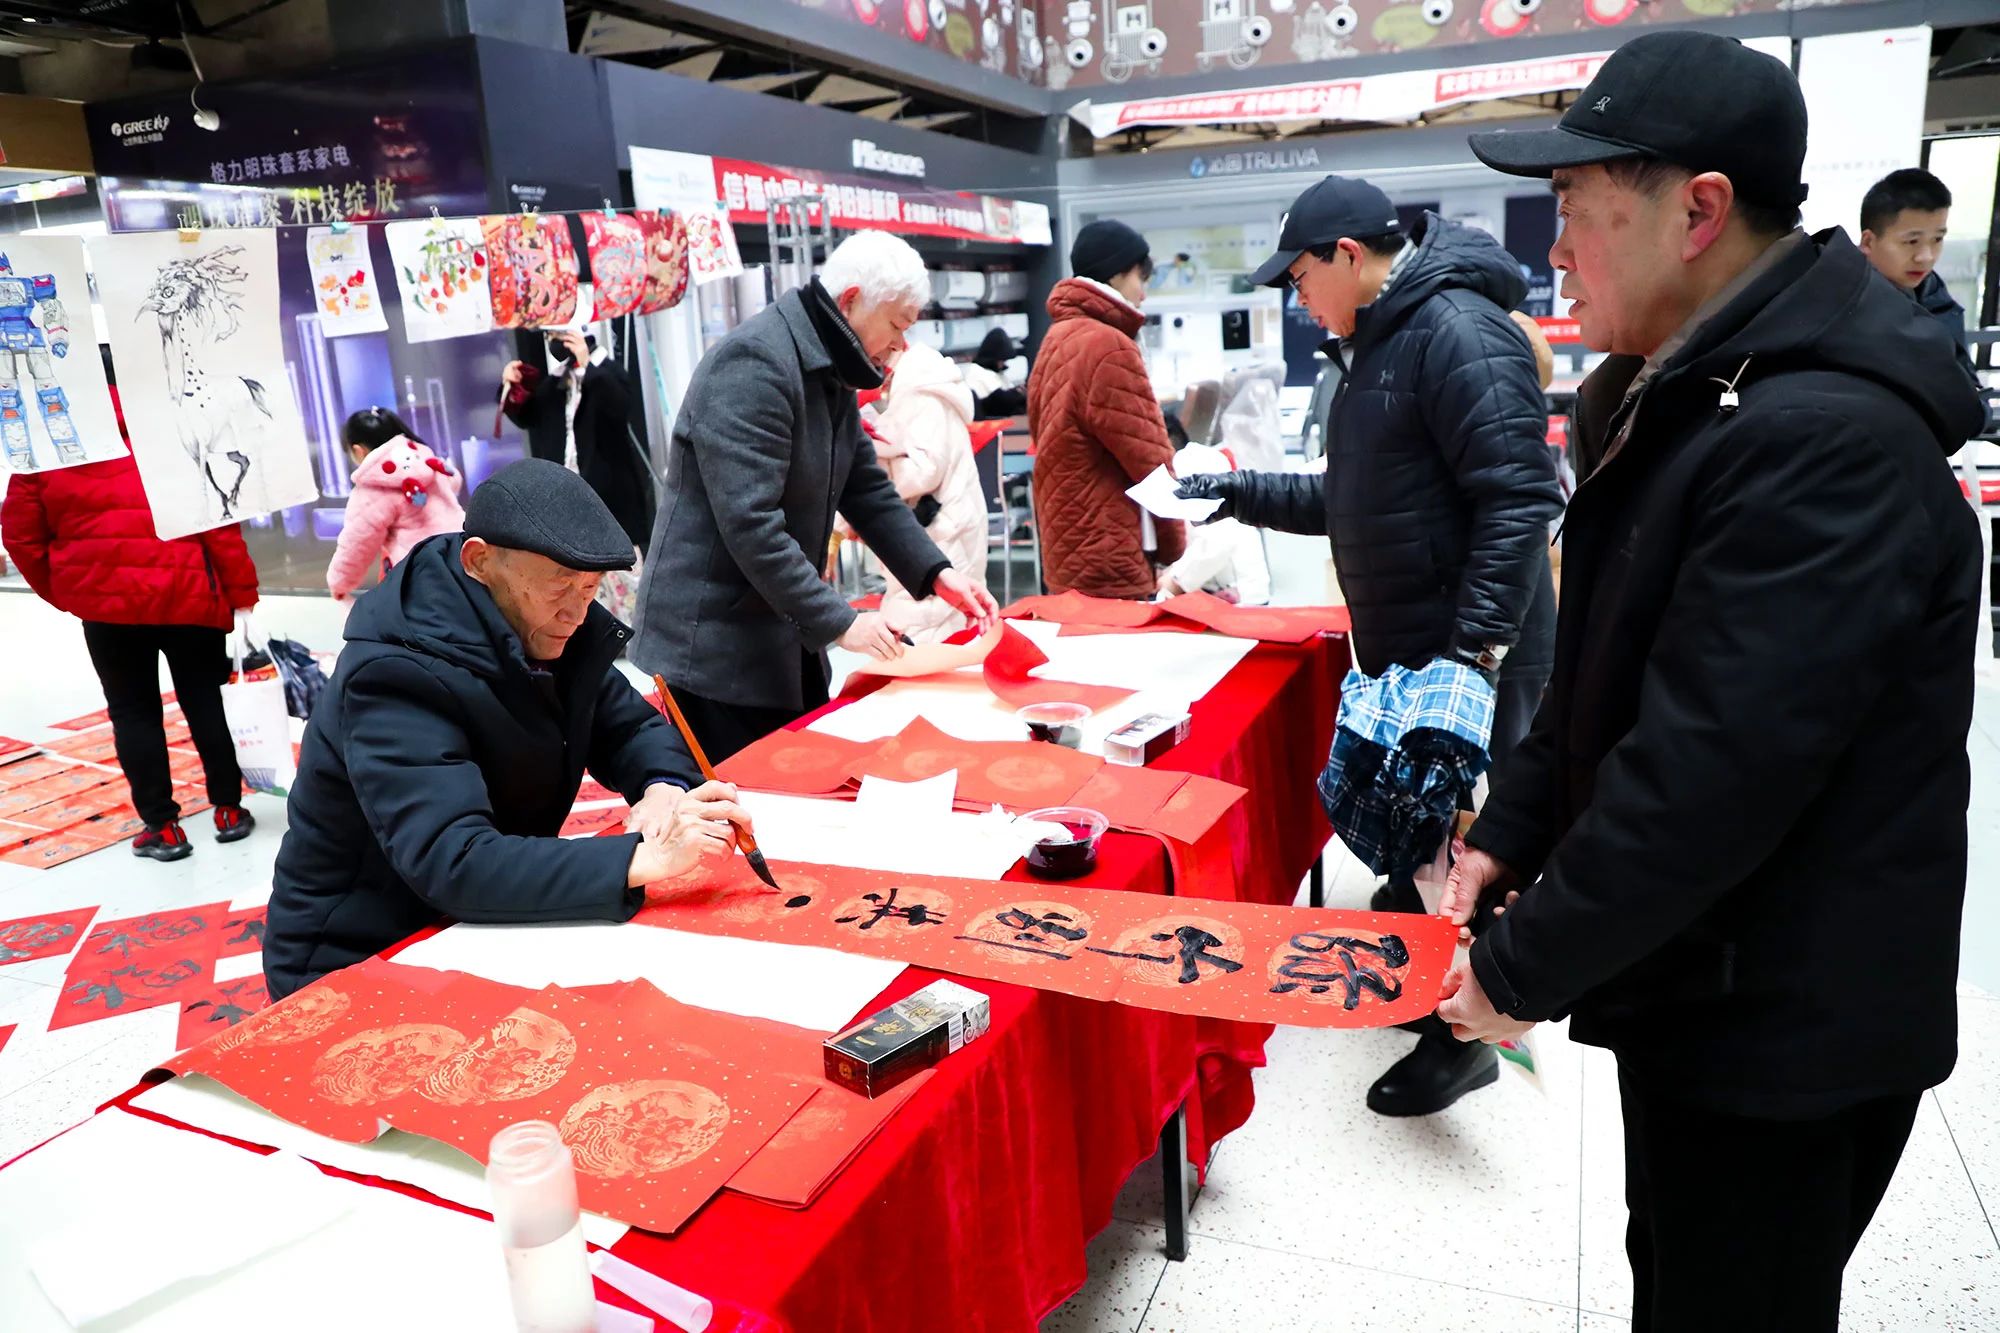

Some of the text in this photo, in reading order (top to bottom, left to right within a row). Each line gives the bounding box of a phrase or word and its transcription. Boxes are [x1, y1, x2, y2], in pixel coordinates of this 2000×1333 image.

[123, 119, 153, 135] GREE
[210, 144, 351, 183] 格力明珠套系家电
[852, 138, 926, 178] Hisense
[1243, 147, 1320, 170] TRULIVA
[290, 177, 400, 225] 科技绽放
